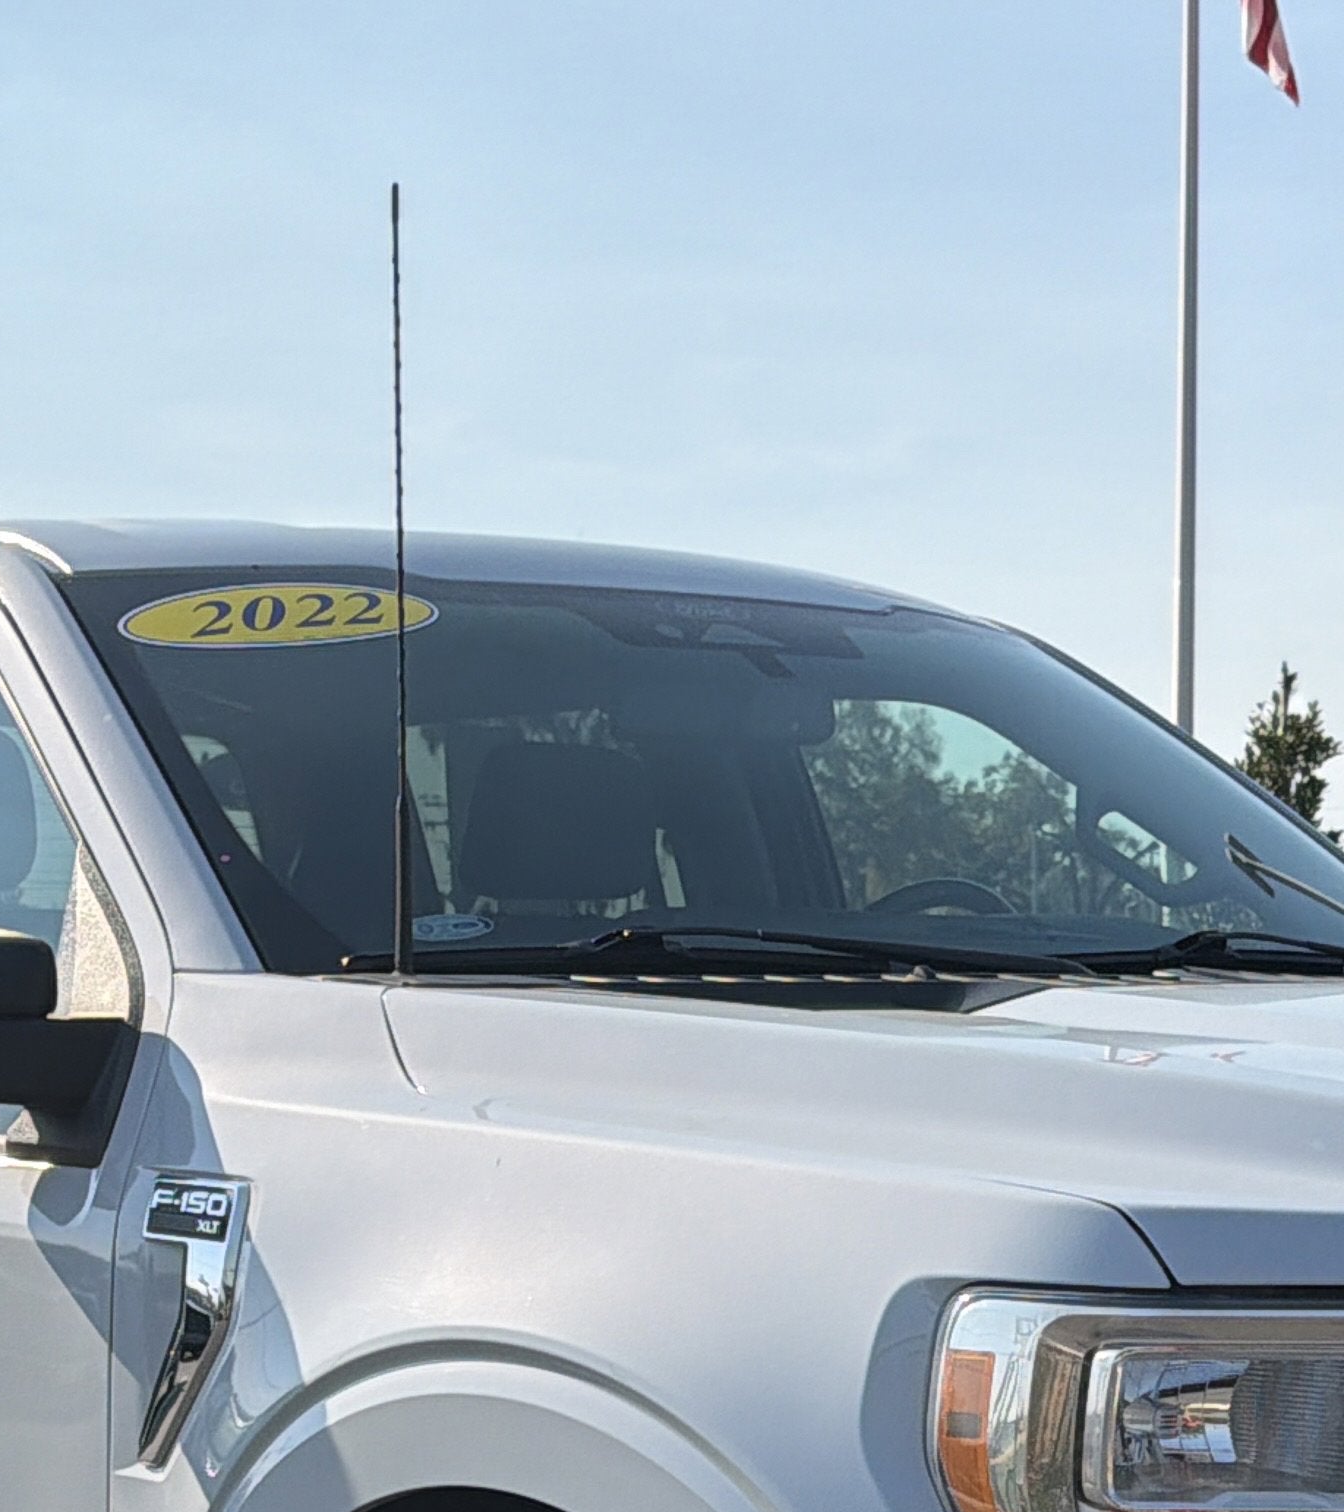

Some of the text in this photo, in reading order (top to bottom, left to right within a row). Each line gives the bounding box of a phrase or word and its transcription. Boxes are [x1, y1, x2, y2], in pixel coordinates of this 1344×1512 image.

[190, 591, 385, 639] 2022
[152, 1188, 228, 1217] F-150
[196, 1218, 222, 1234] XLT
